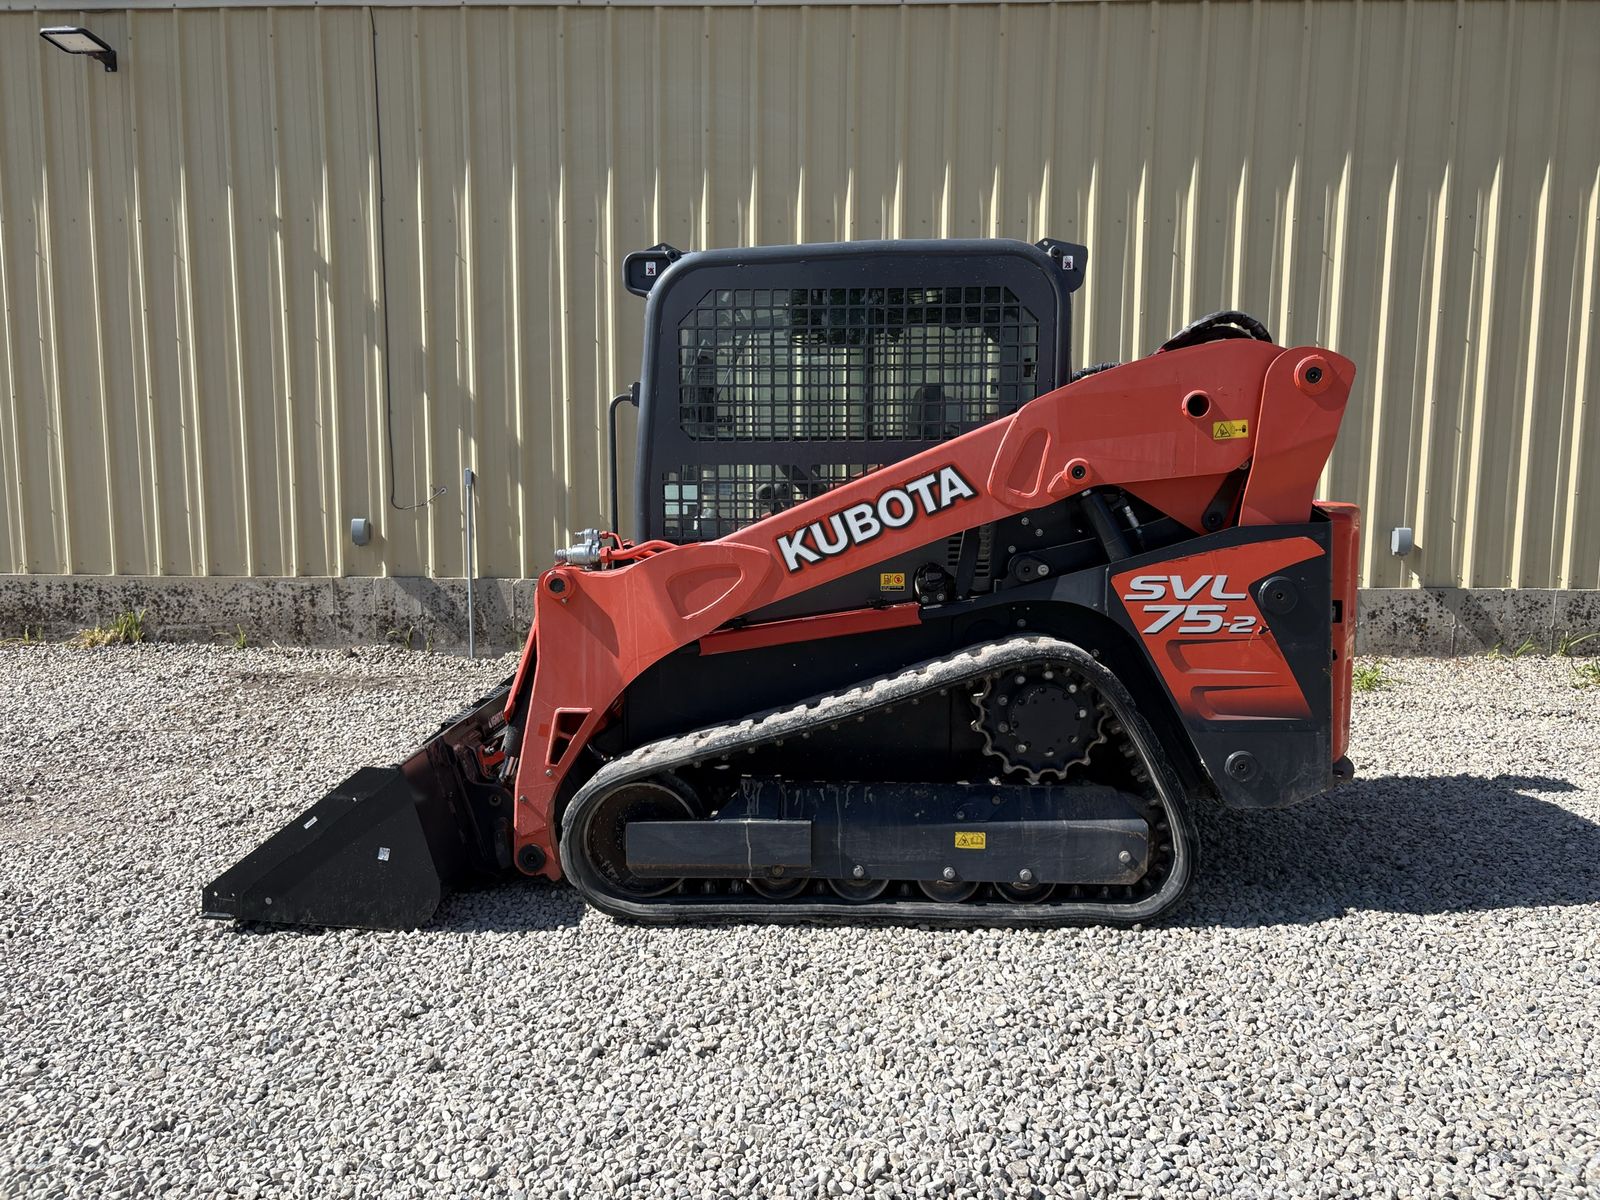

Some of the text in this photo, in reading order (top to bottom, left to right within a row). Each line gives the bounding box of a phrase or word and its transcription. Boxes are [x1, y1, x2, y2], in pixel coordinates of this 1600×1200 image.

[776, 466, 976, 572] KUBOTA
[1123, 574, 1247, 600] SVL
[1142, 604, 1257, 634] 75-2
